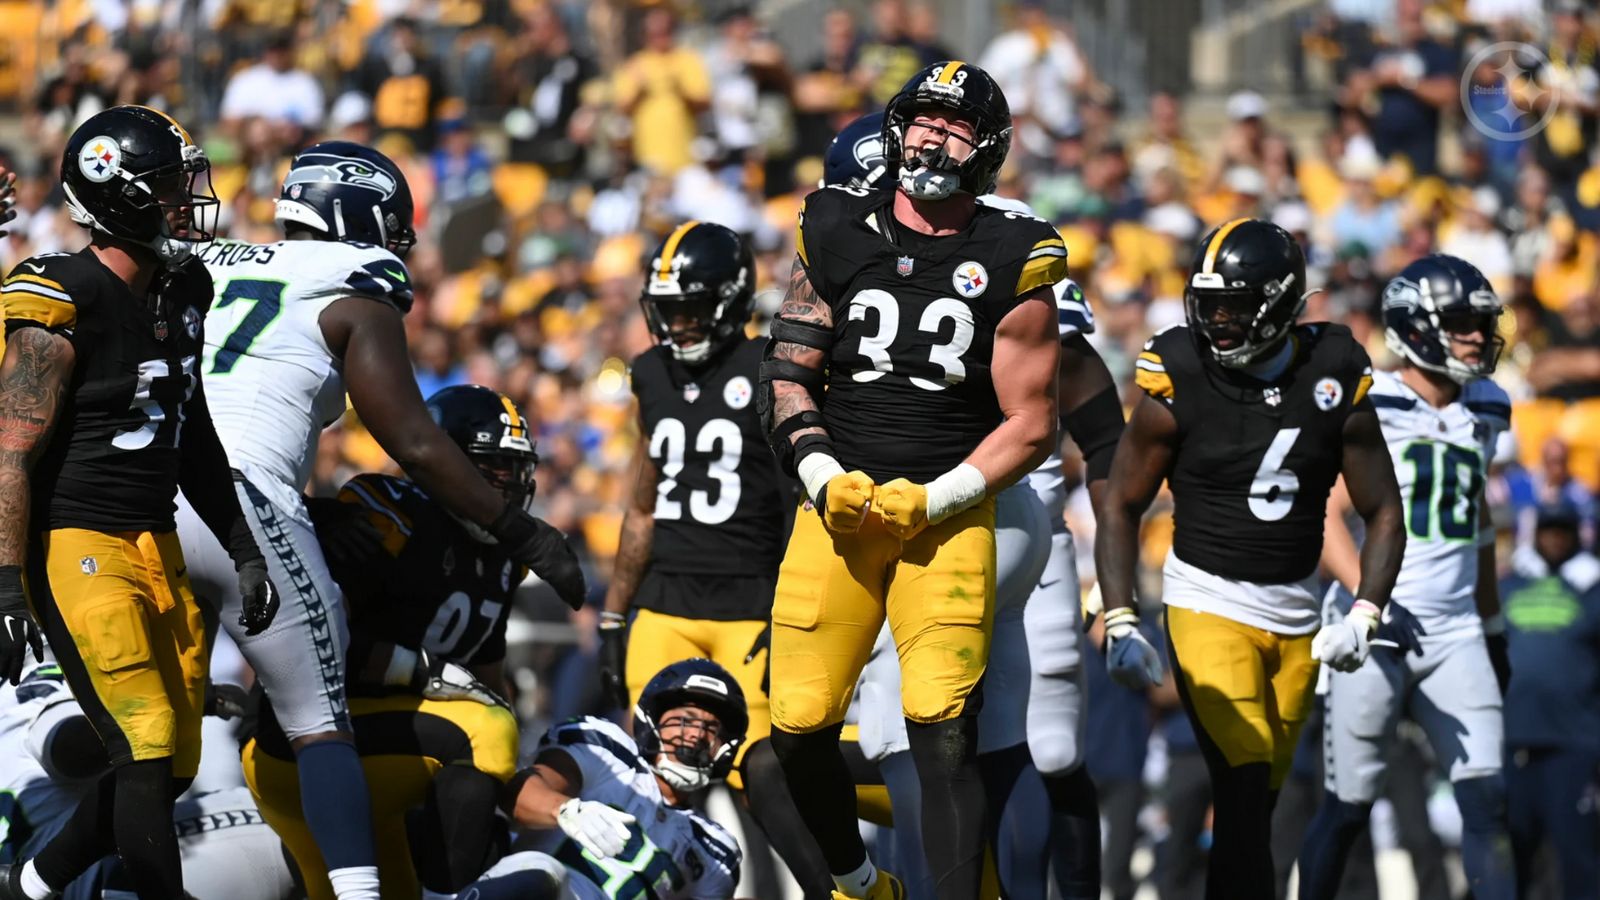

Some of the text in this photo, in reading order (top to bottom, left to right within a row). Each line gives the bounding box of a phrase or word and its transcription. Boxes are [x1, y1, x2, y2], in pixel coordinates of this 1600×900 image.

[926, 66, 968, 87] 33
[200, 241, 284, 266] CROSS
[848, 288, 975, 391] 33
[649, 417, 743, 525] 23
[1247, 427, 1301, 521] 6
[1400, 440, 1483, 543] 10
